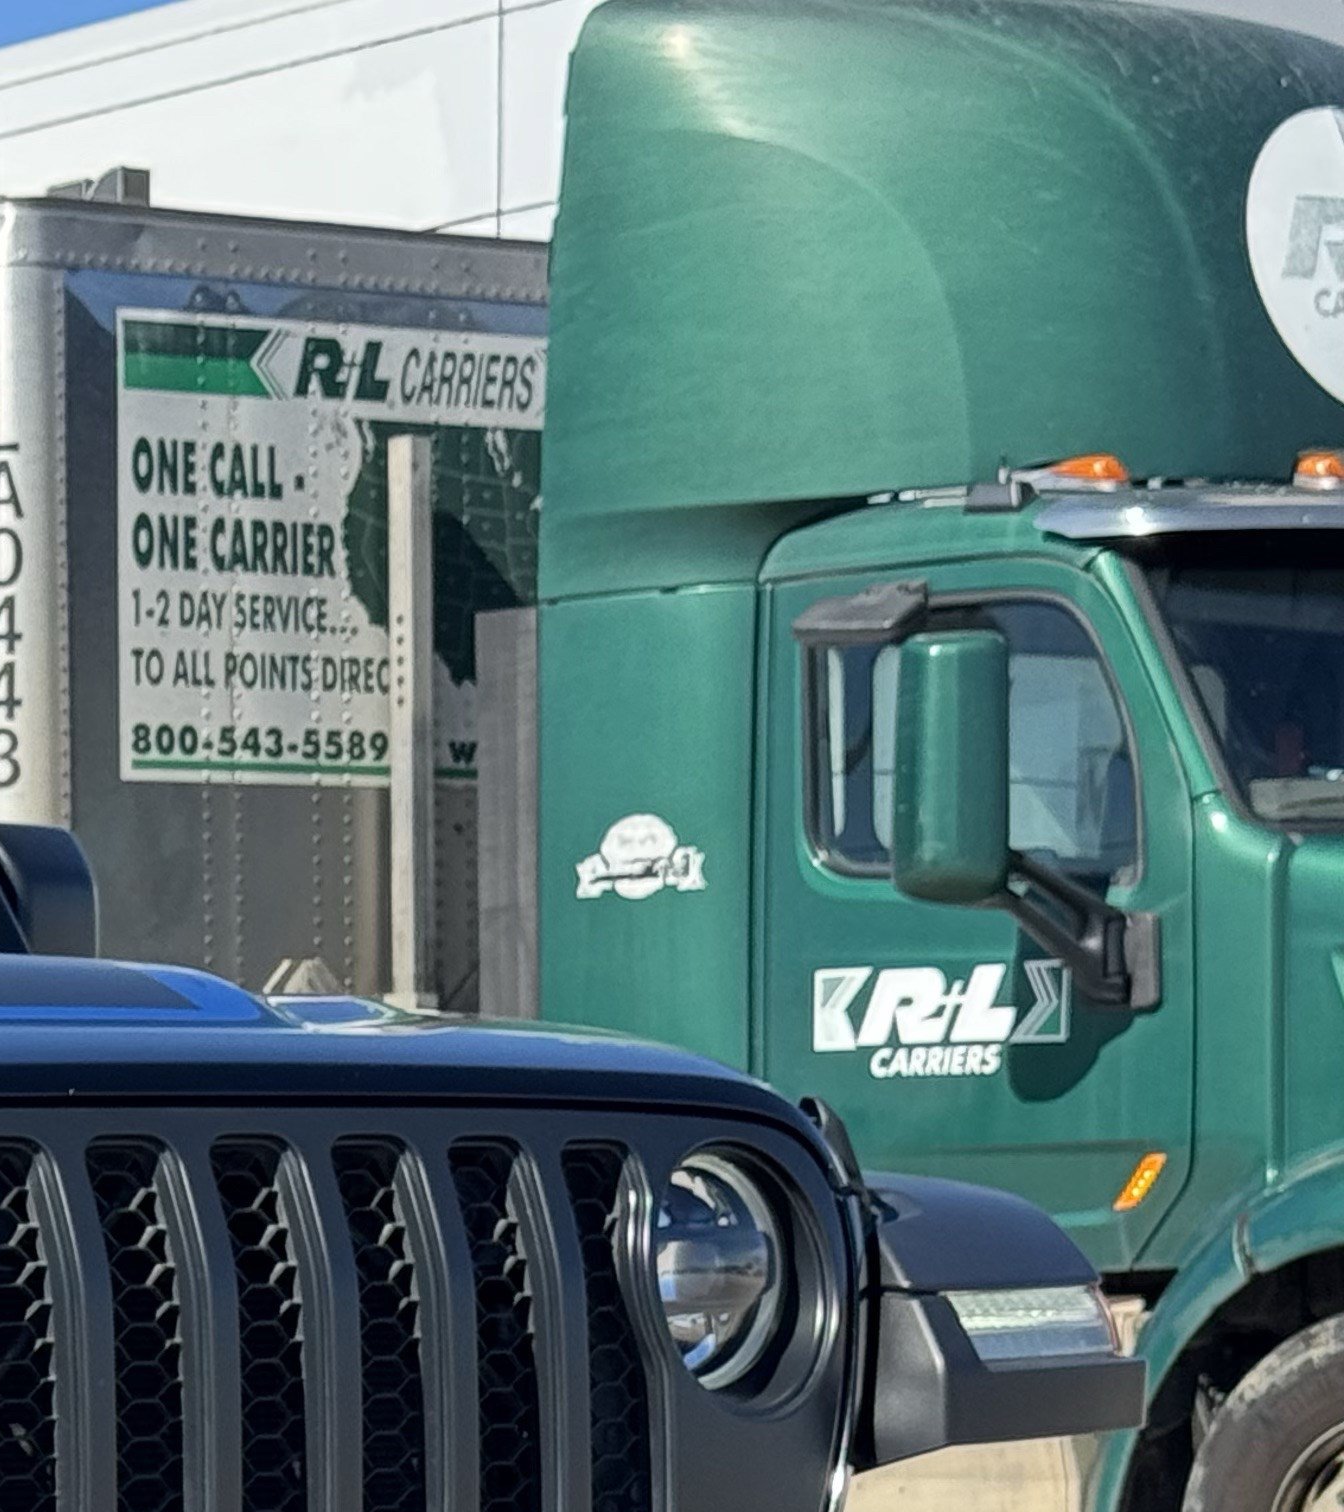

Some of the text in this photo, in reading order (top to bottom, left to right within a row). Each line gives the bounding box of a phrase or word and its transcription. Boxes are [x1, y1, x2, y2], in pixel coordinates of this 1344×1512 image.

[399, 346, 537, 411] CARRIERS
[131, 436, 197, 495] ONE
[209, 441, 283, 500] CALL
[131, 512, 336, 578] ONE CARRIER
[131, 588, 170, 627] 1-2
[178, 590, 228, 630] DAY
[130, 647, 390, 696] TO ALL POINTS DIREC
[131, 722, 390, 762] 800-543-5589
[868, 1044, 1004, 1079] CARRIERS
